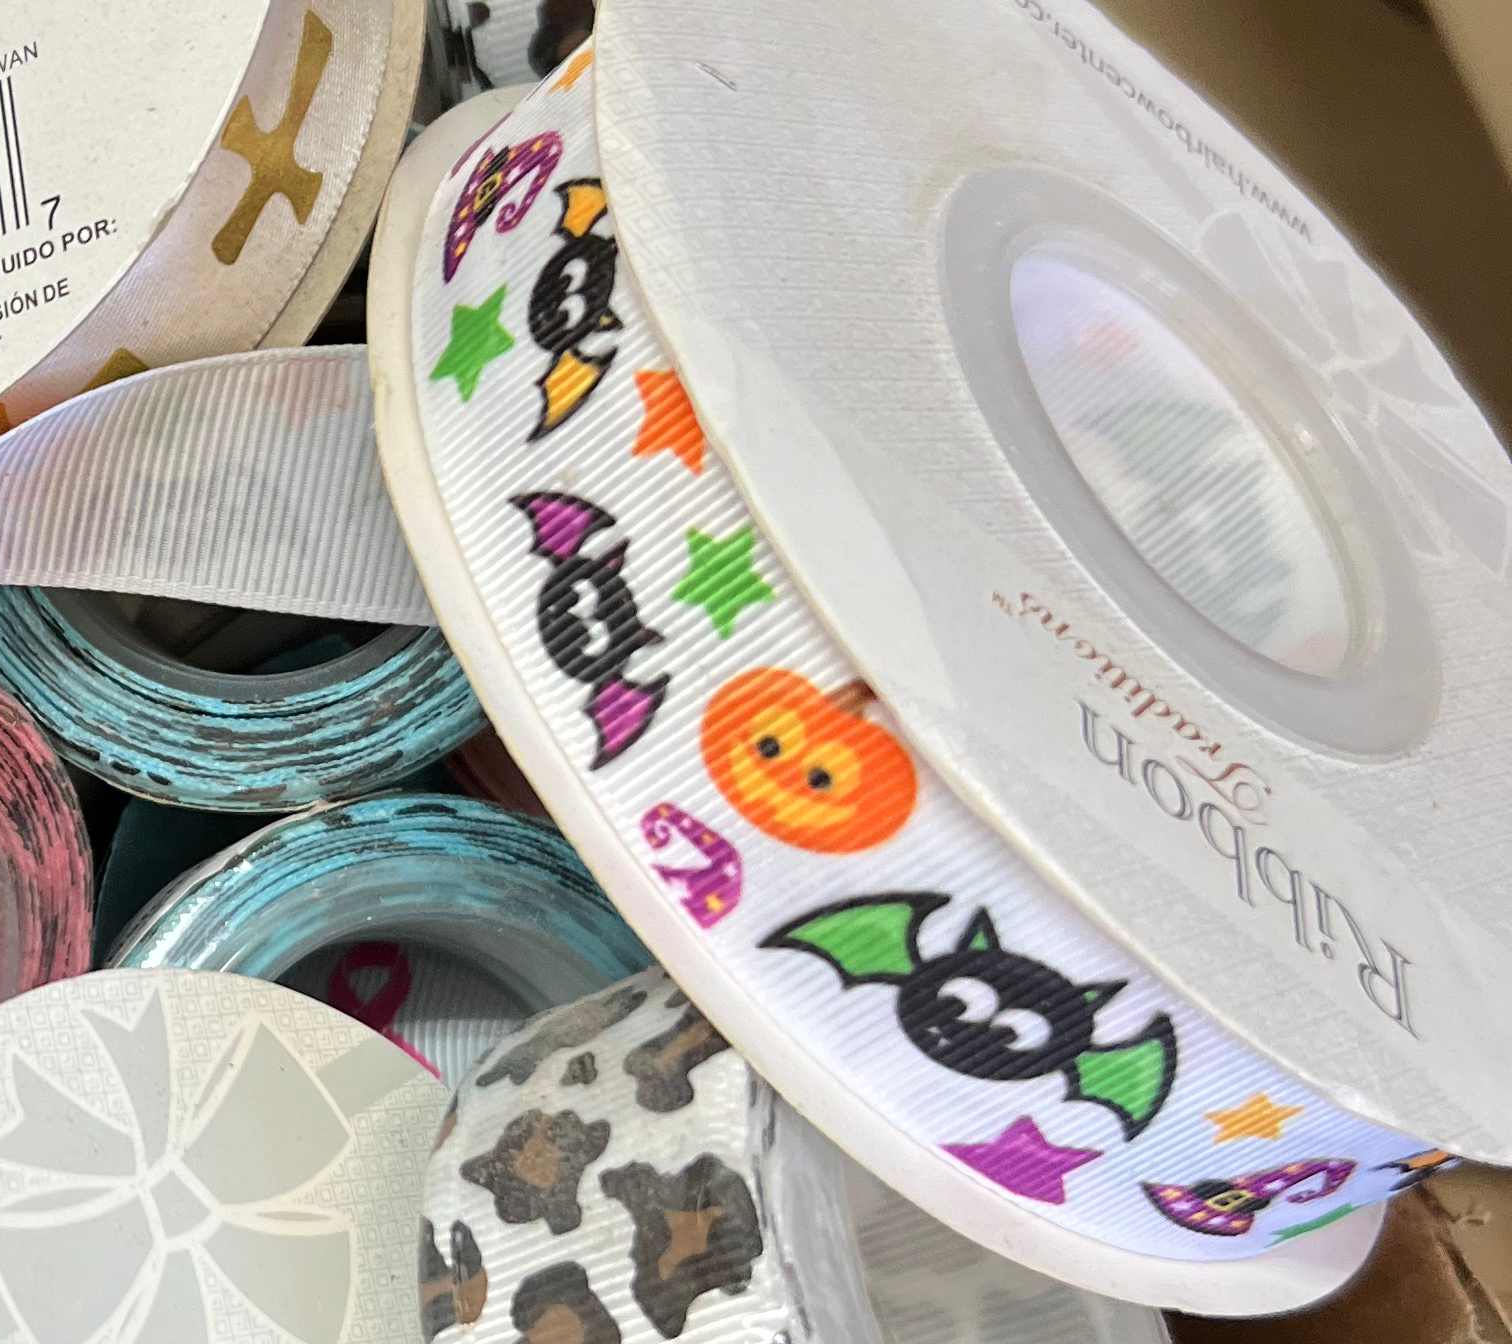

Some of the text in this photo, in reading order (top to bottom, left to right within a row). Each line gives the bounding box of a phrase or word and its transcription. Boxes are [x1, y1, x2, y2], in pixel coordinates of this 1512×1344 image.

[40, 194, 62, 232] 7
[60, 218, 118, 253] POR:
[42, 277, 72, 304] DE
[1077, 698, 1421, 1041] Ribbon
